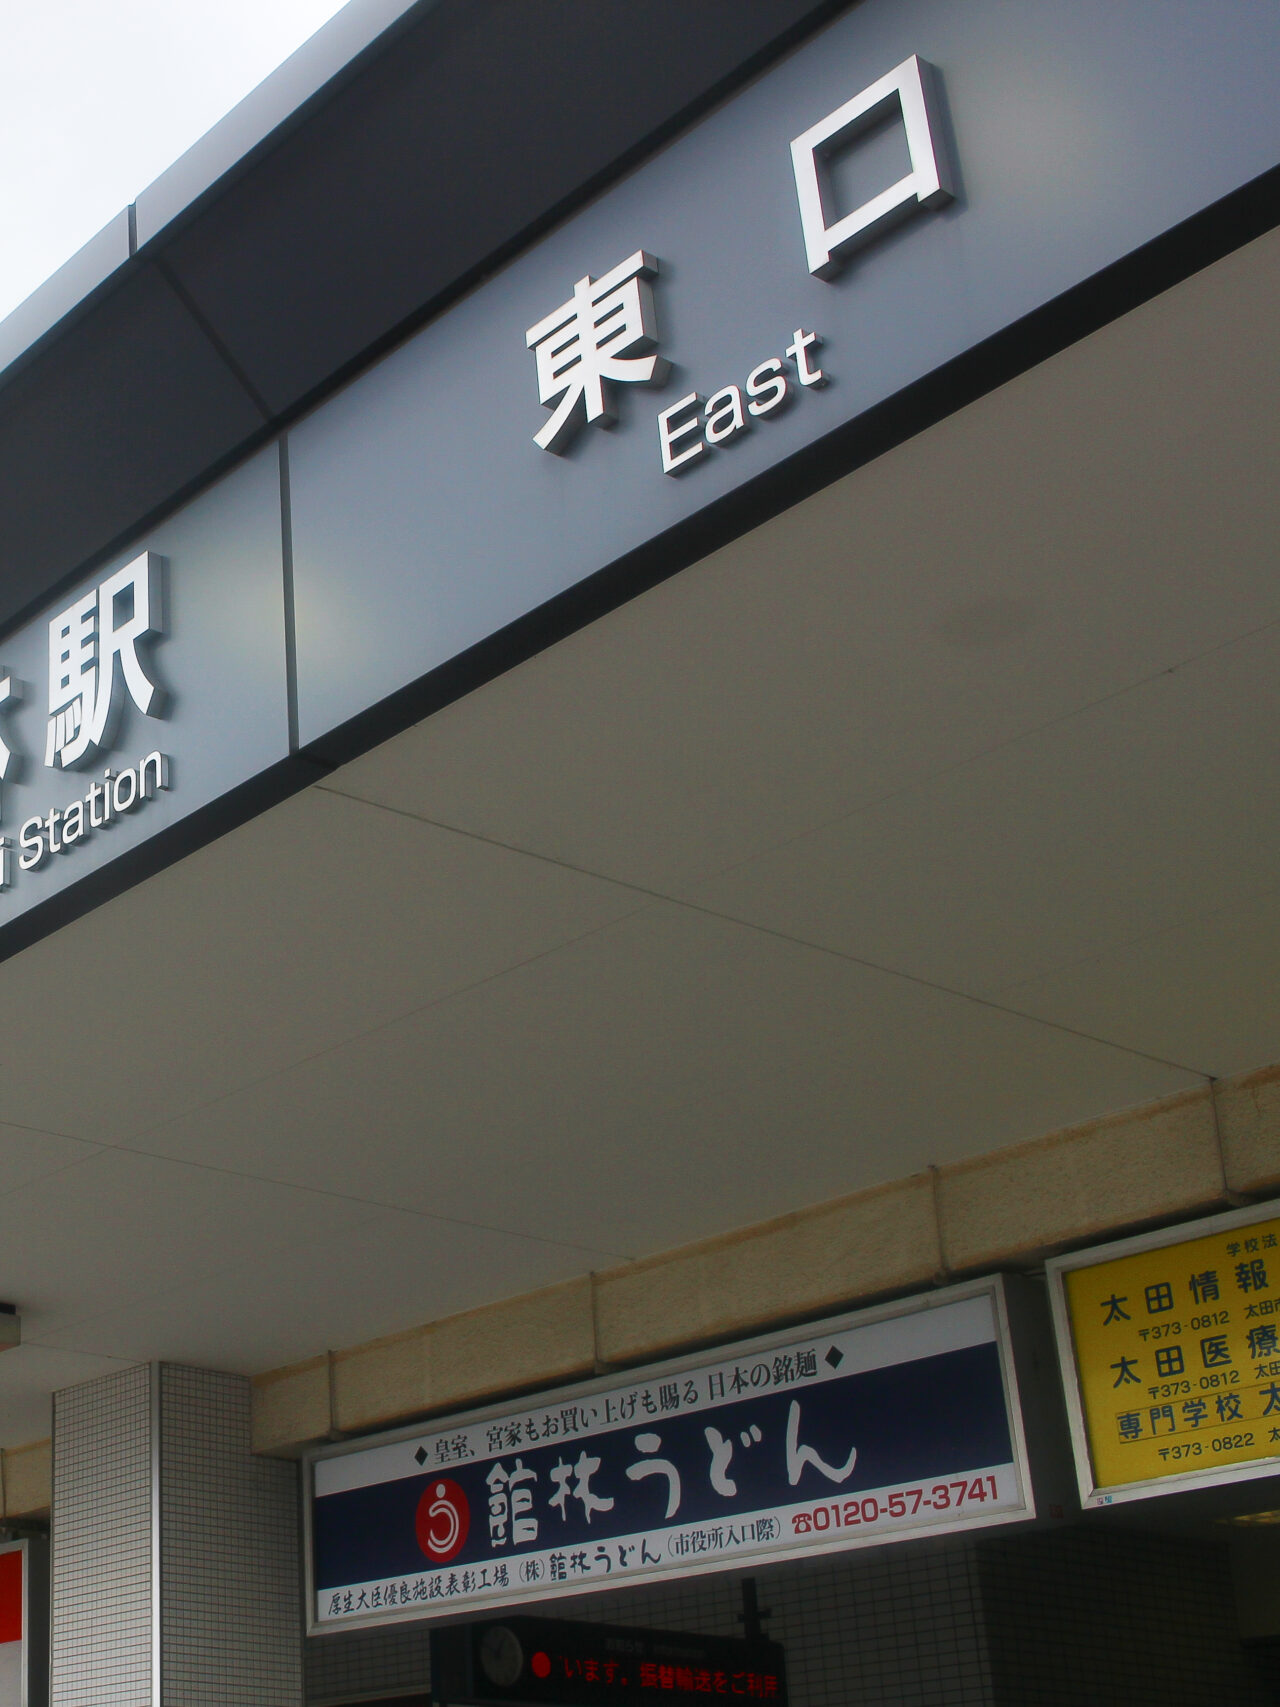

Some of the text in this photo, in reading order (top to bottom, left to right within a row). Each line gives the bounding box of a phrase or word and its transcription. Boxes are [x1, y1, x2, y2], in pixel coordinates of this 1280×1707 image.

[526, 54, 948, 450] 東口
[657, 328, 826, 475] East
[19, 750, 167, 870] Station
[1100, 1258, 1268, 1325] 太田情報
[1109, 1323, 1280, 1388] 太田医療
[486, 1400, 857, 1548] 館林うどん
[1117, 1392, 1244, 1440] 専門学校
